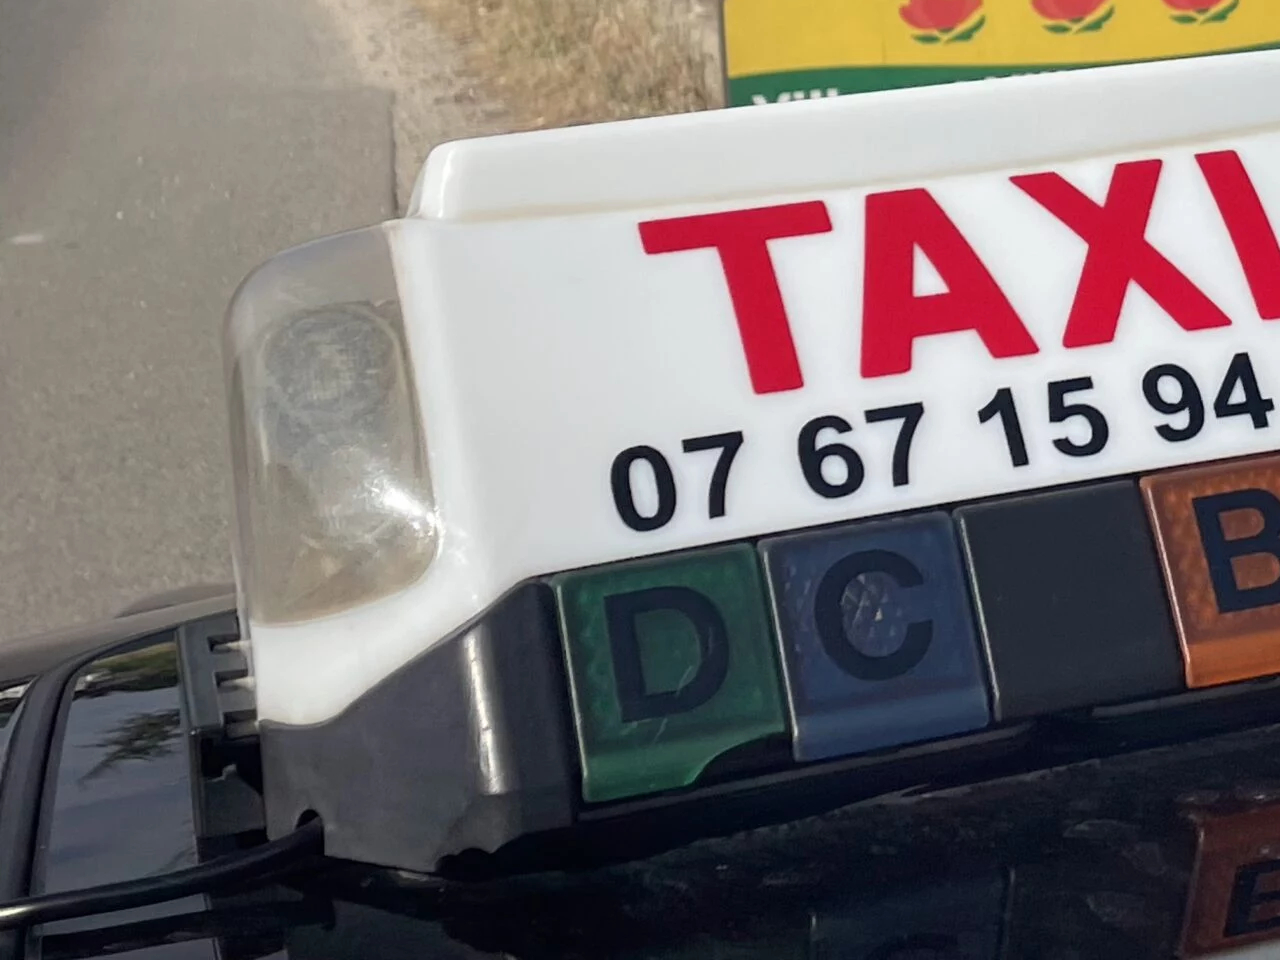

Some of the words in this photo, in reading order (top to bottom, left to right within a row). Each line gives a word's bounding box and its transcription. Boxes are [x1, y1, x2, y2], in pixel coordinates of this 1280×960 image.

[610, 430, 744, 533] 07
[797, 401, 925, 499] 67
[977, 376, 1109, 468] 15
[1142, 352, 1275, 443] 94
[603, 585, 732, 725] D
[813, 548, 934, 682] C
